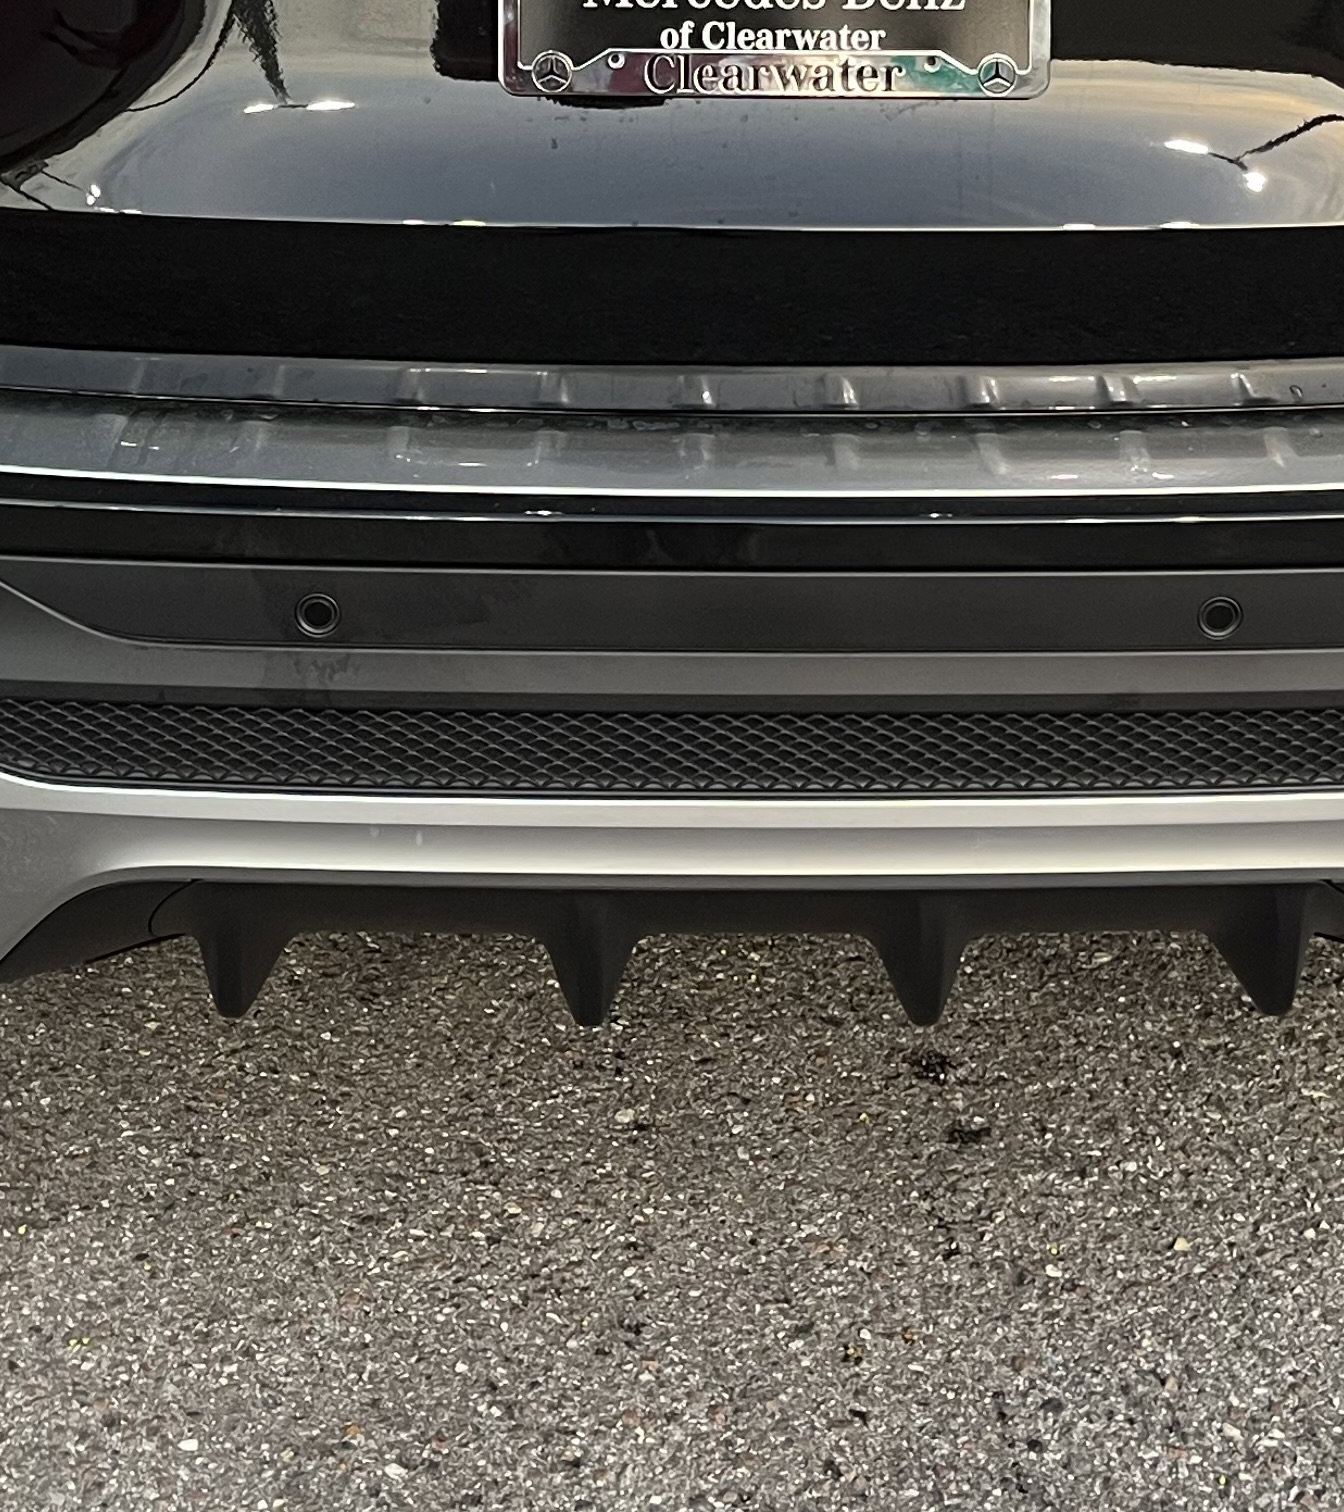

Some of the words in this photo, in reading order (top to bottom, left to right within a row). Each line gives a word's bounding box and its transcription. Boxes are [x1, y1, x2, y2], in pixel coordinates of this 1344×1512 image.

[659, 20, 695, 50] of
[702, 20, 887, 51] Clearwater
[643, 53, 906, 94] Clearwater
